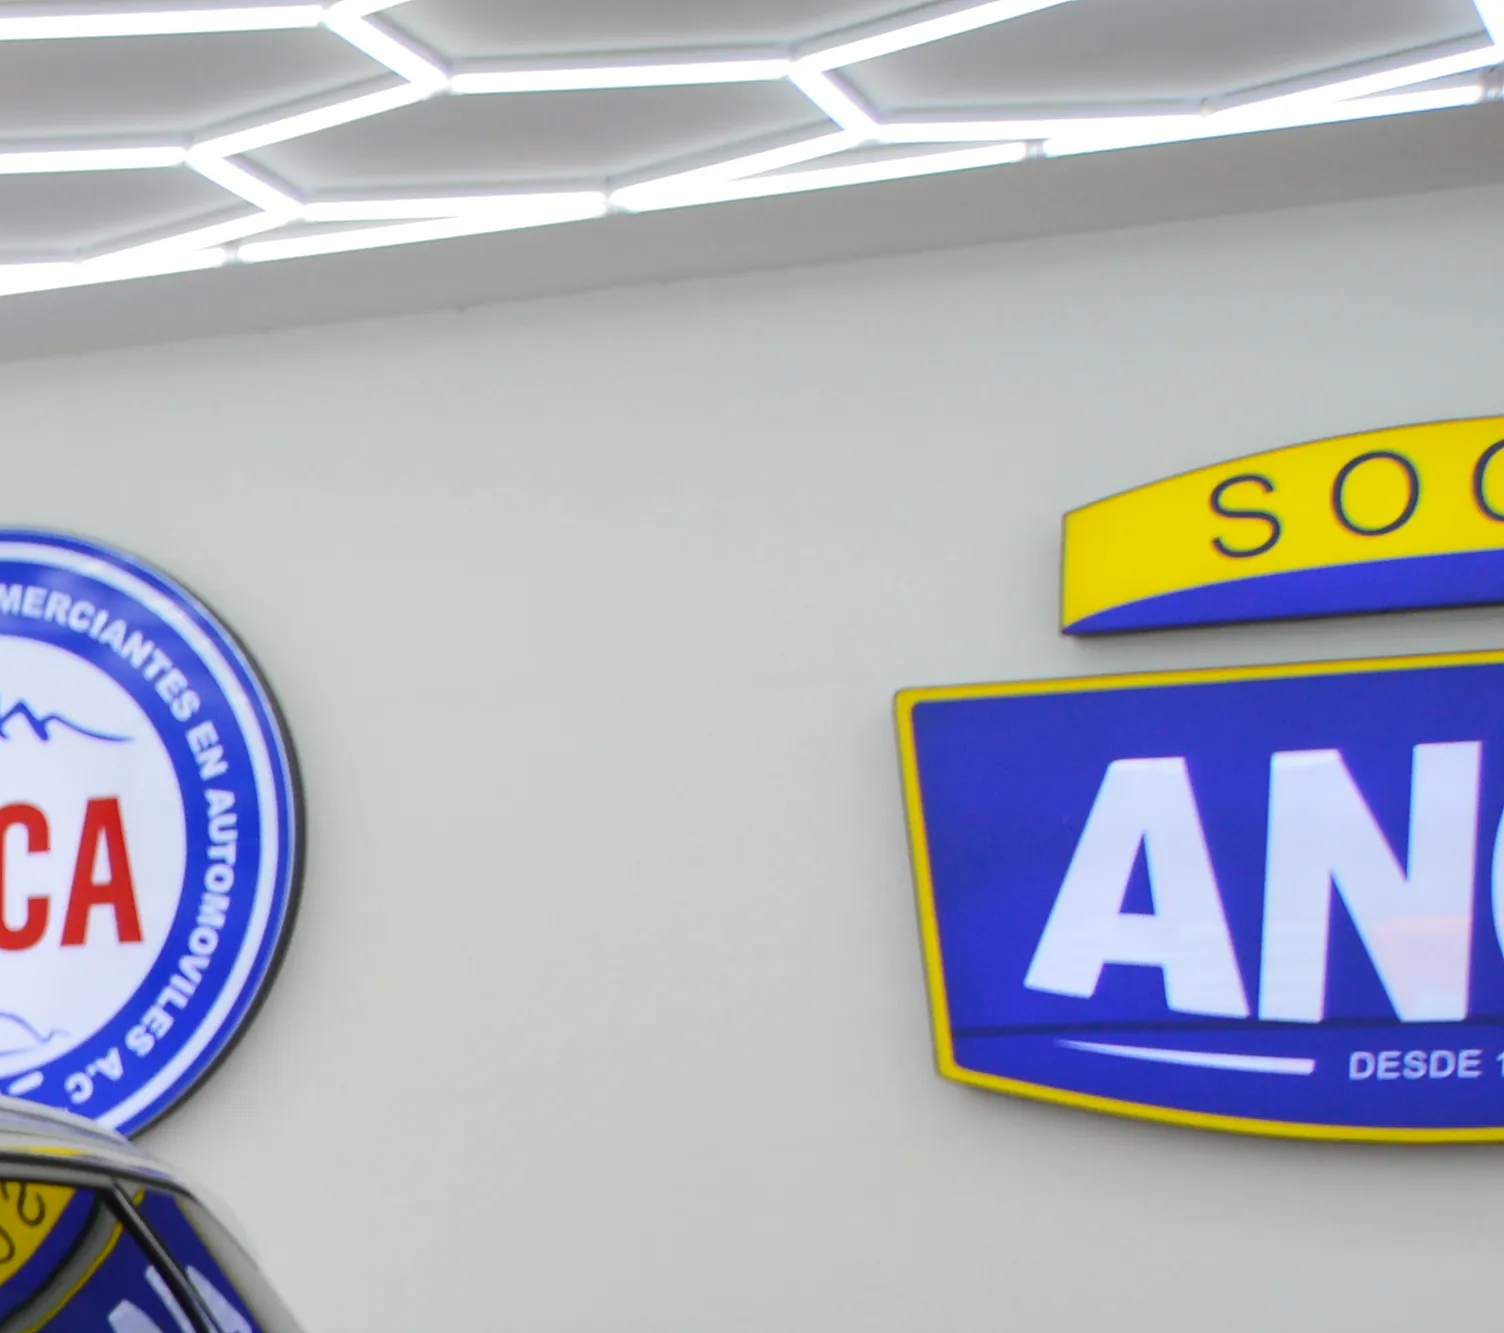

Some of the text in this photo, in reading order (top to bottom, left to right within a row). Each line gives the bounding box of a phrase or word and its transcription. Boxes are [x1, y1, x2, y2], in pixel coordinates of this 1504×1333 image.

[185, 720, 230, 782] EN
[124, 788, 238, 1058] AUTOMOVILES
[1024, 741, 1504, 1024] AN
[1348, 1048, 1484, 1082] DESDE
